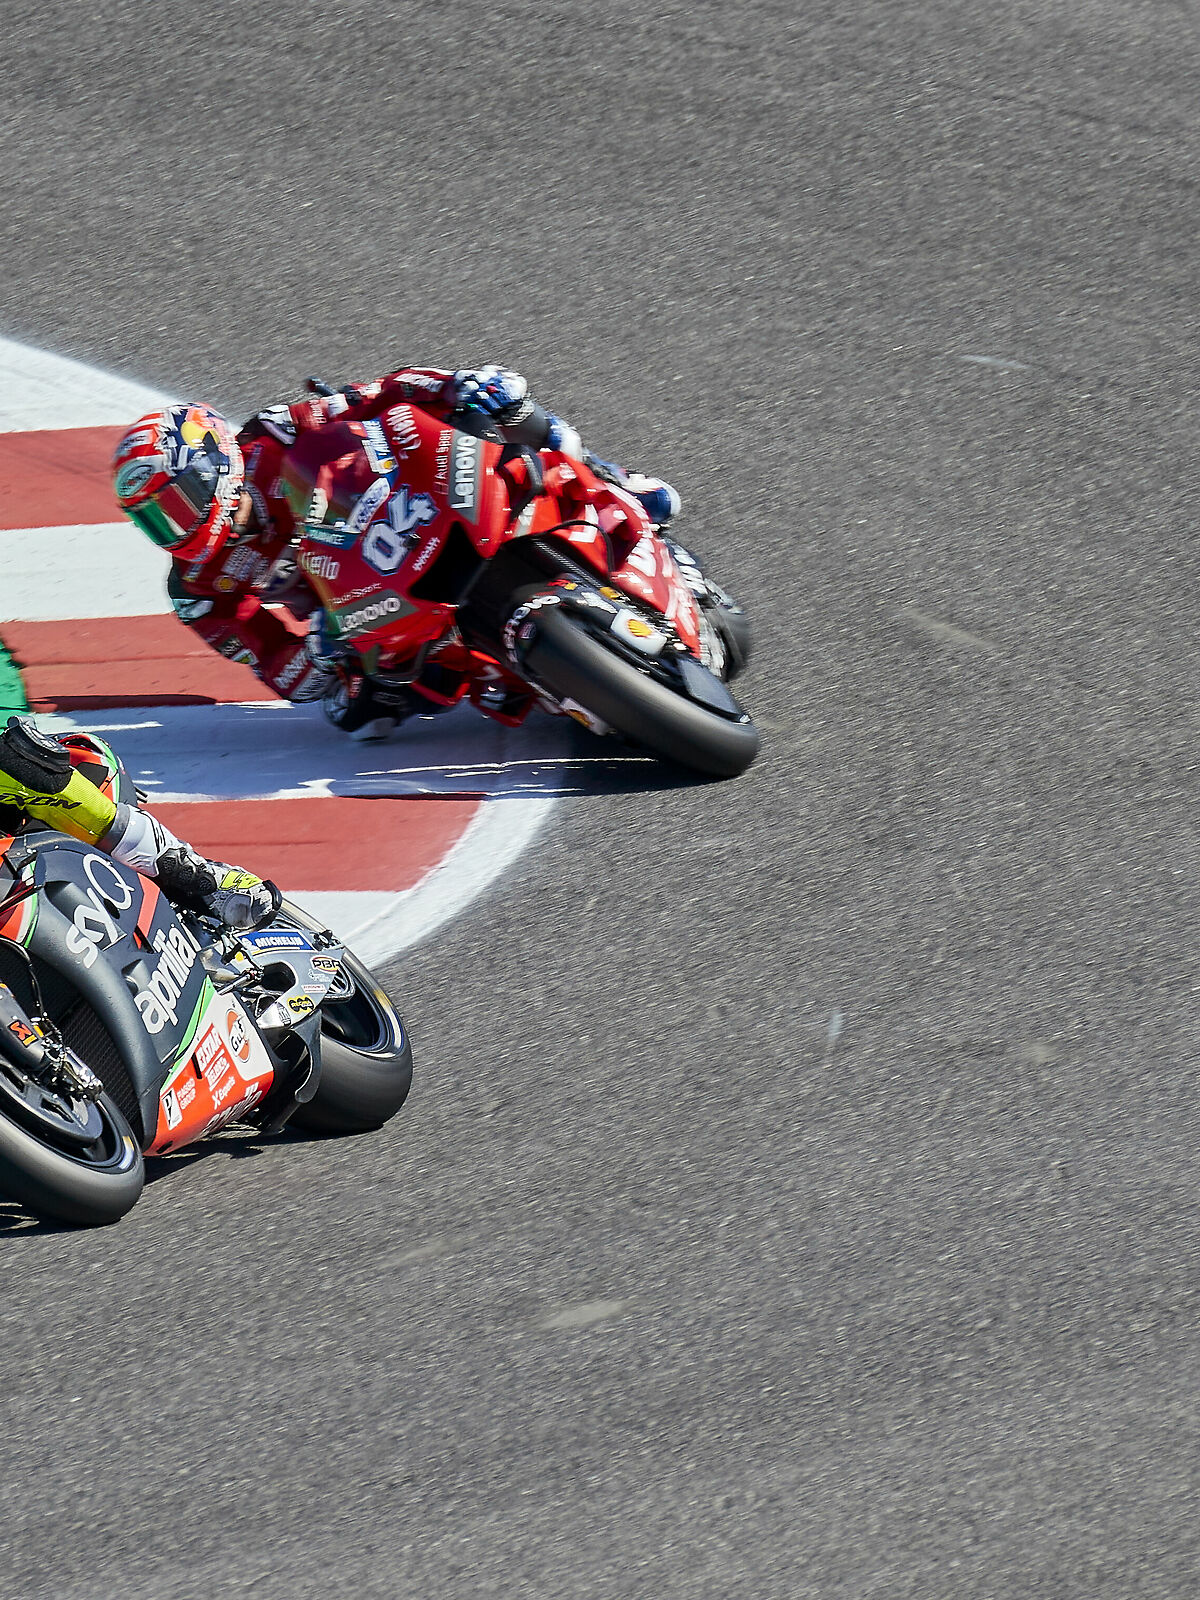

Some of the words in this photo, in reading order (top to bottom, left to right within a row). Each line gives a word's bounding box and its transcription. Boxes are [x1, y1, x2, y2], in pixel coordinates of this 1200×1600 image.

[451, 435, 478, 509] Lenovo
[361, 484, 440, 576] 04
[133, 927, 197, 1034] aprilia
[255, 937, 304, 947] MICHELIN
